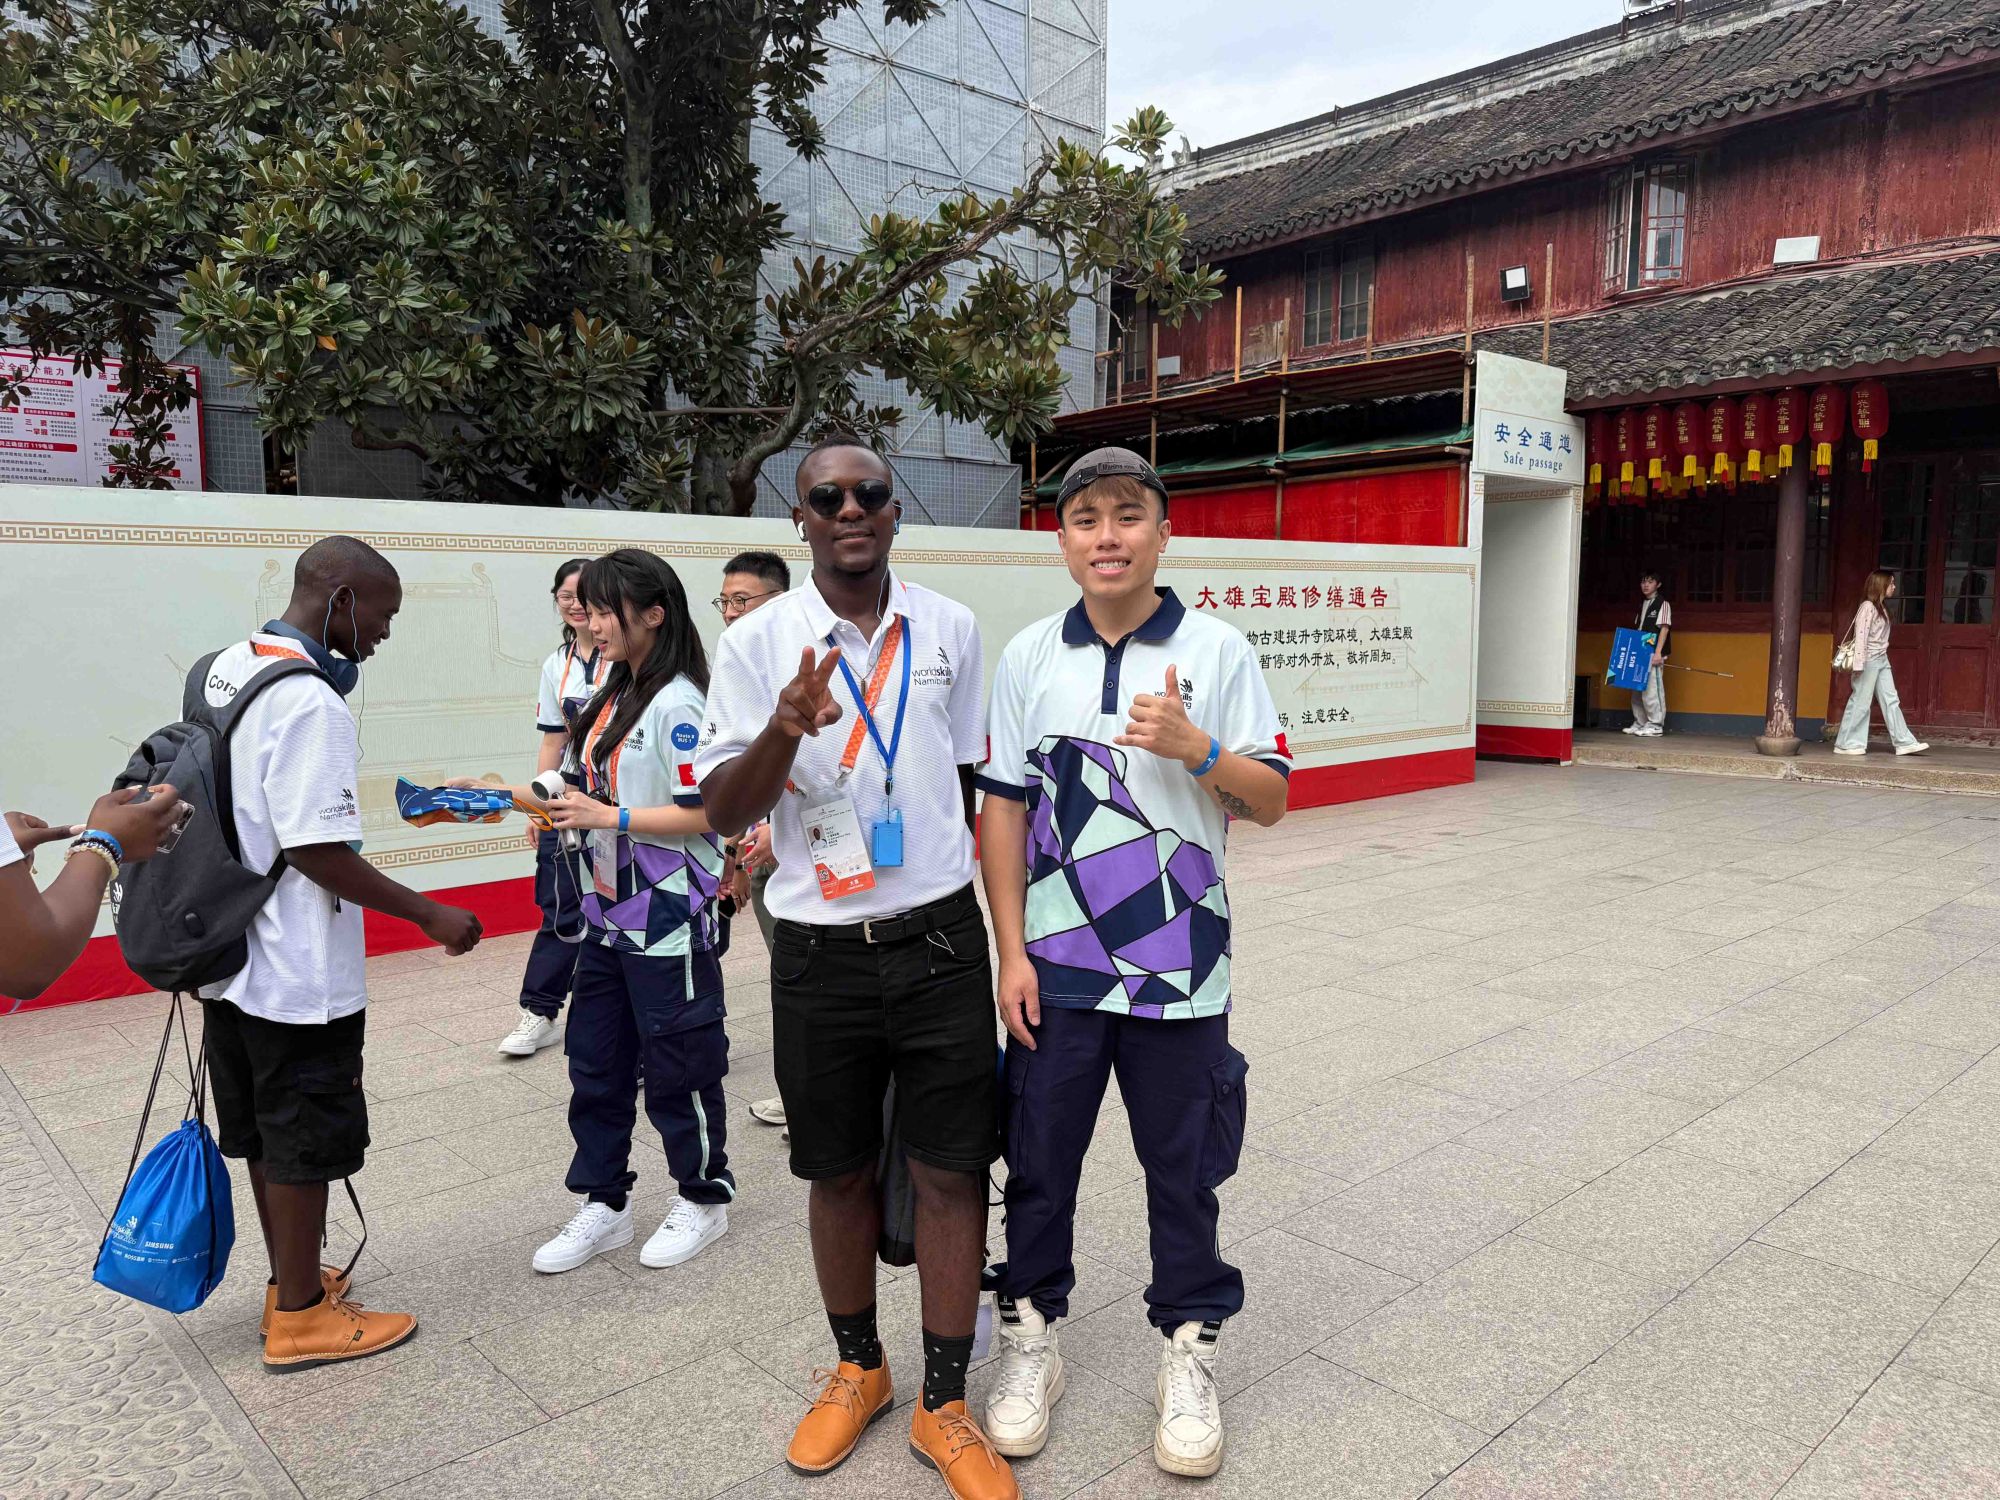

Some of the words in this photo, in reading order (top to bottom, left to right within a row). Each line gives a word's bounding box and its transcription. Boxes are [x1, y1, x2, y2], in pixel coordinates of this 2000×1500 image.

[1494, 422, 1572, 454] 安全通道
[1503, 450, 1524, 465] Safe
[1529, 457, 1563, 474] passage
[1194, 585, 1389, 610] 大雄宝殿修缮通告
